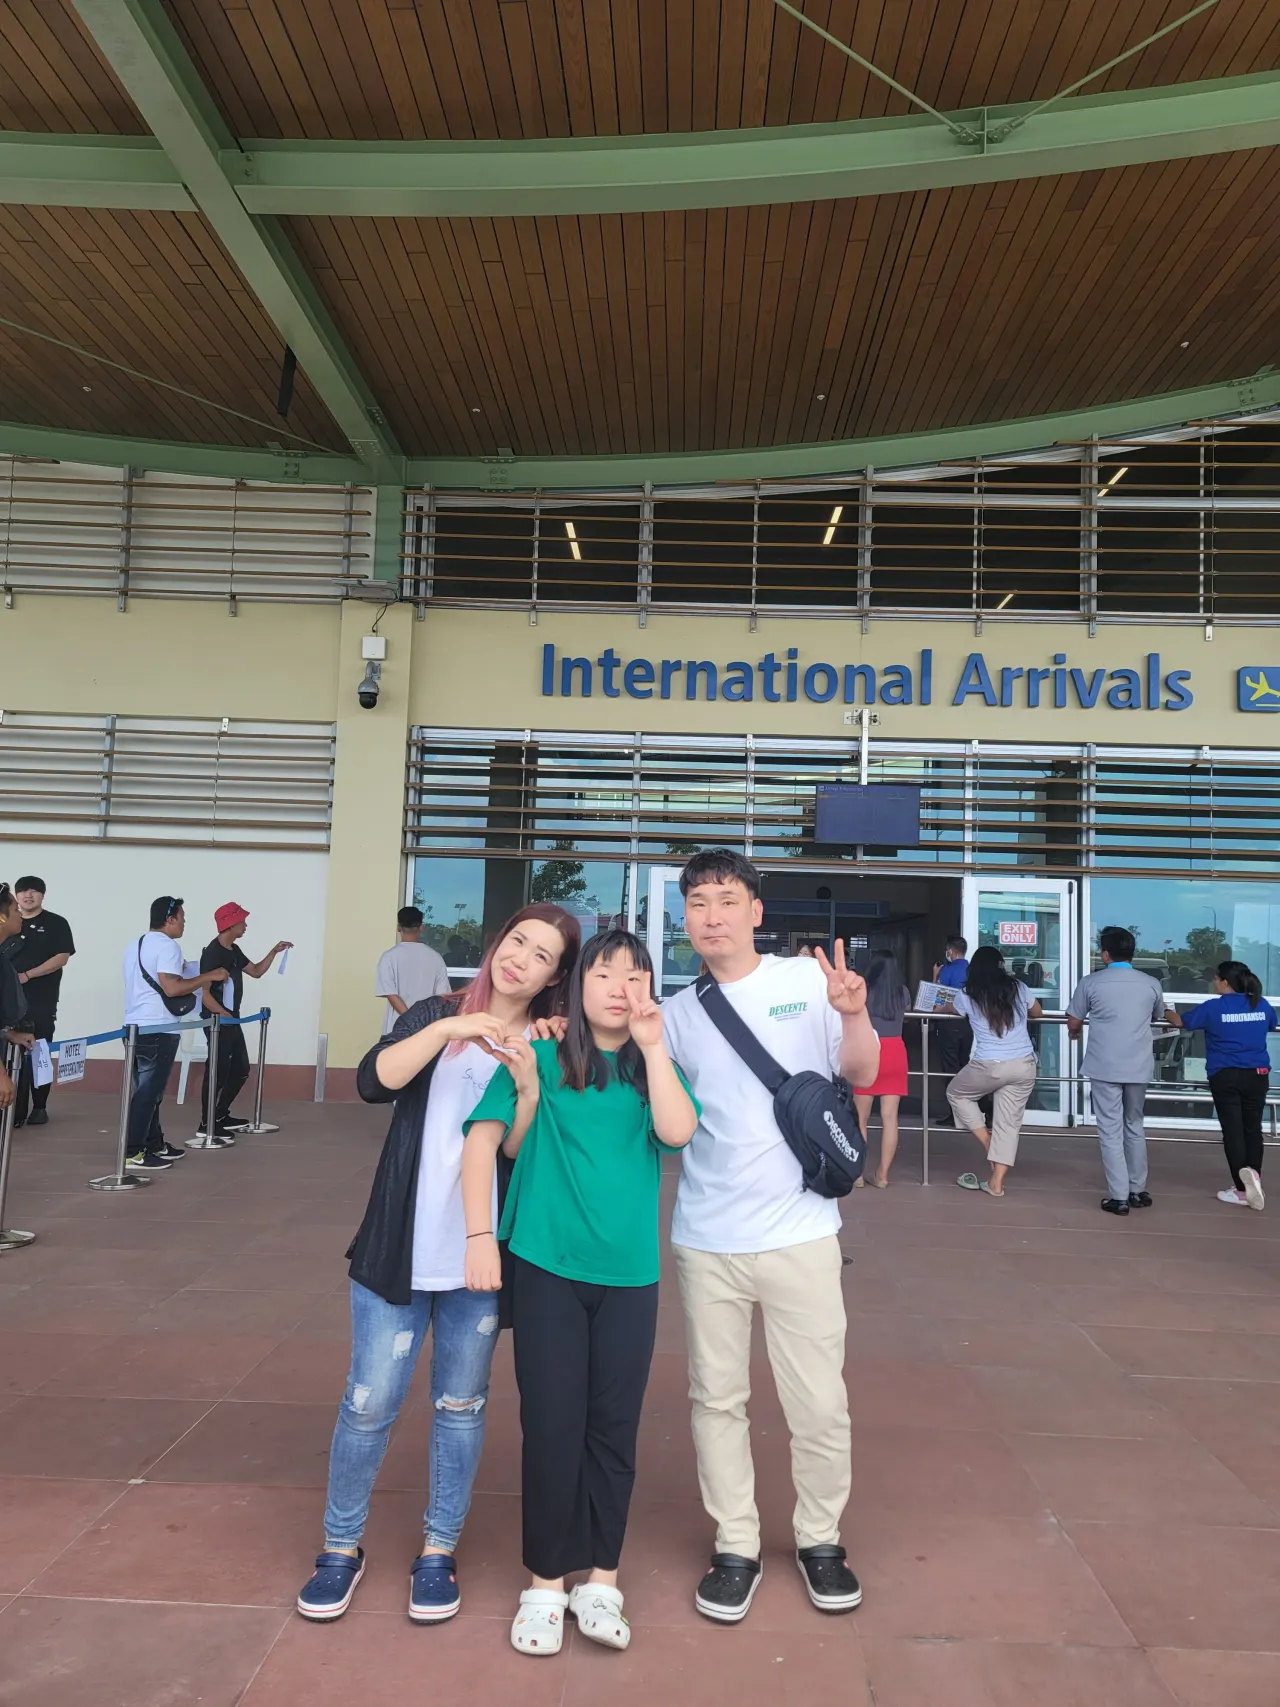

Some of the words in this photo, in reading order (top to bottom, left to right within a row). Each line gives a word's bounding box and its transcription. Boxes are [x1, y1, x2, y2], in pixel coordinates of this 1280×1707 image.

[542, 643, 933, 705] International
[952, 652, 1194, 710] Arrivals
[1004, 924, 1031, 934] EXIT
[1002, 933, 1034, 943] ONLY
[768, 1001, 808, 1017] DESCENTE
[65, 1043, 81, 1058] HOTEL
